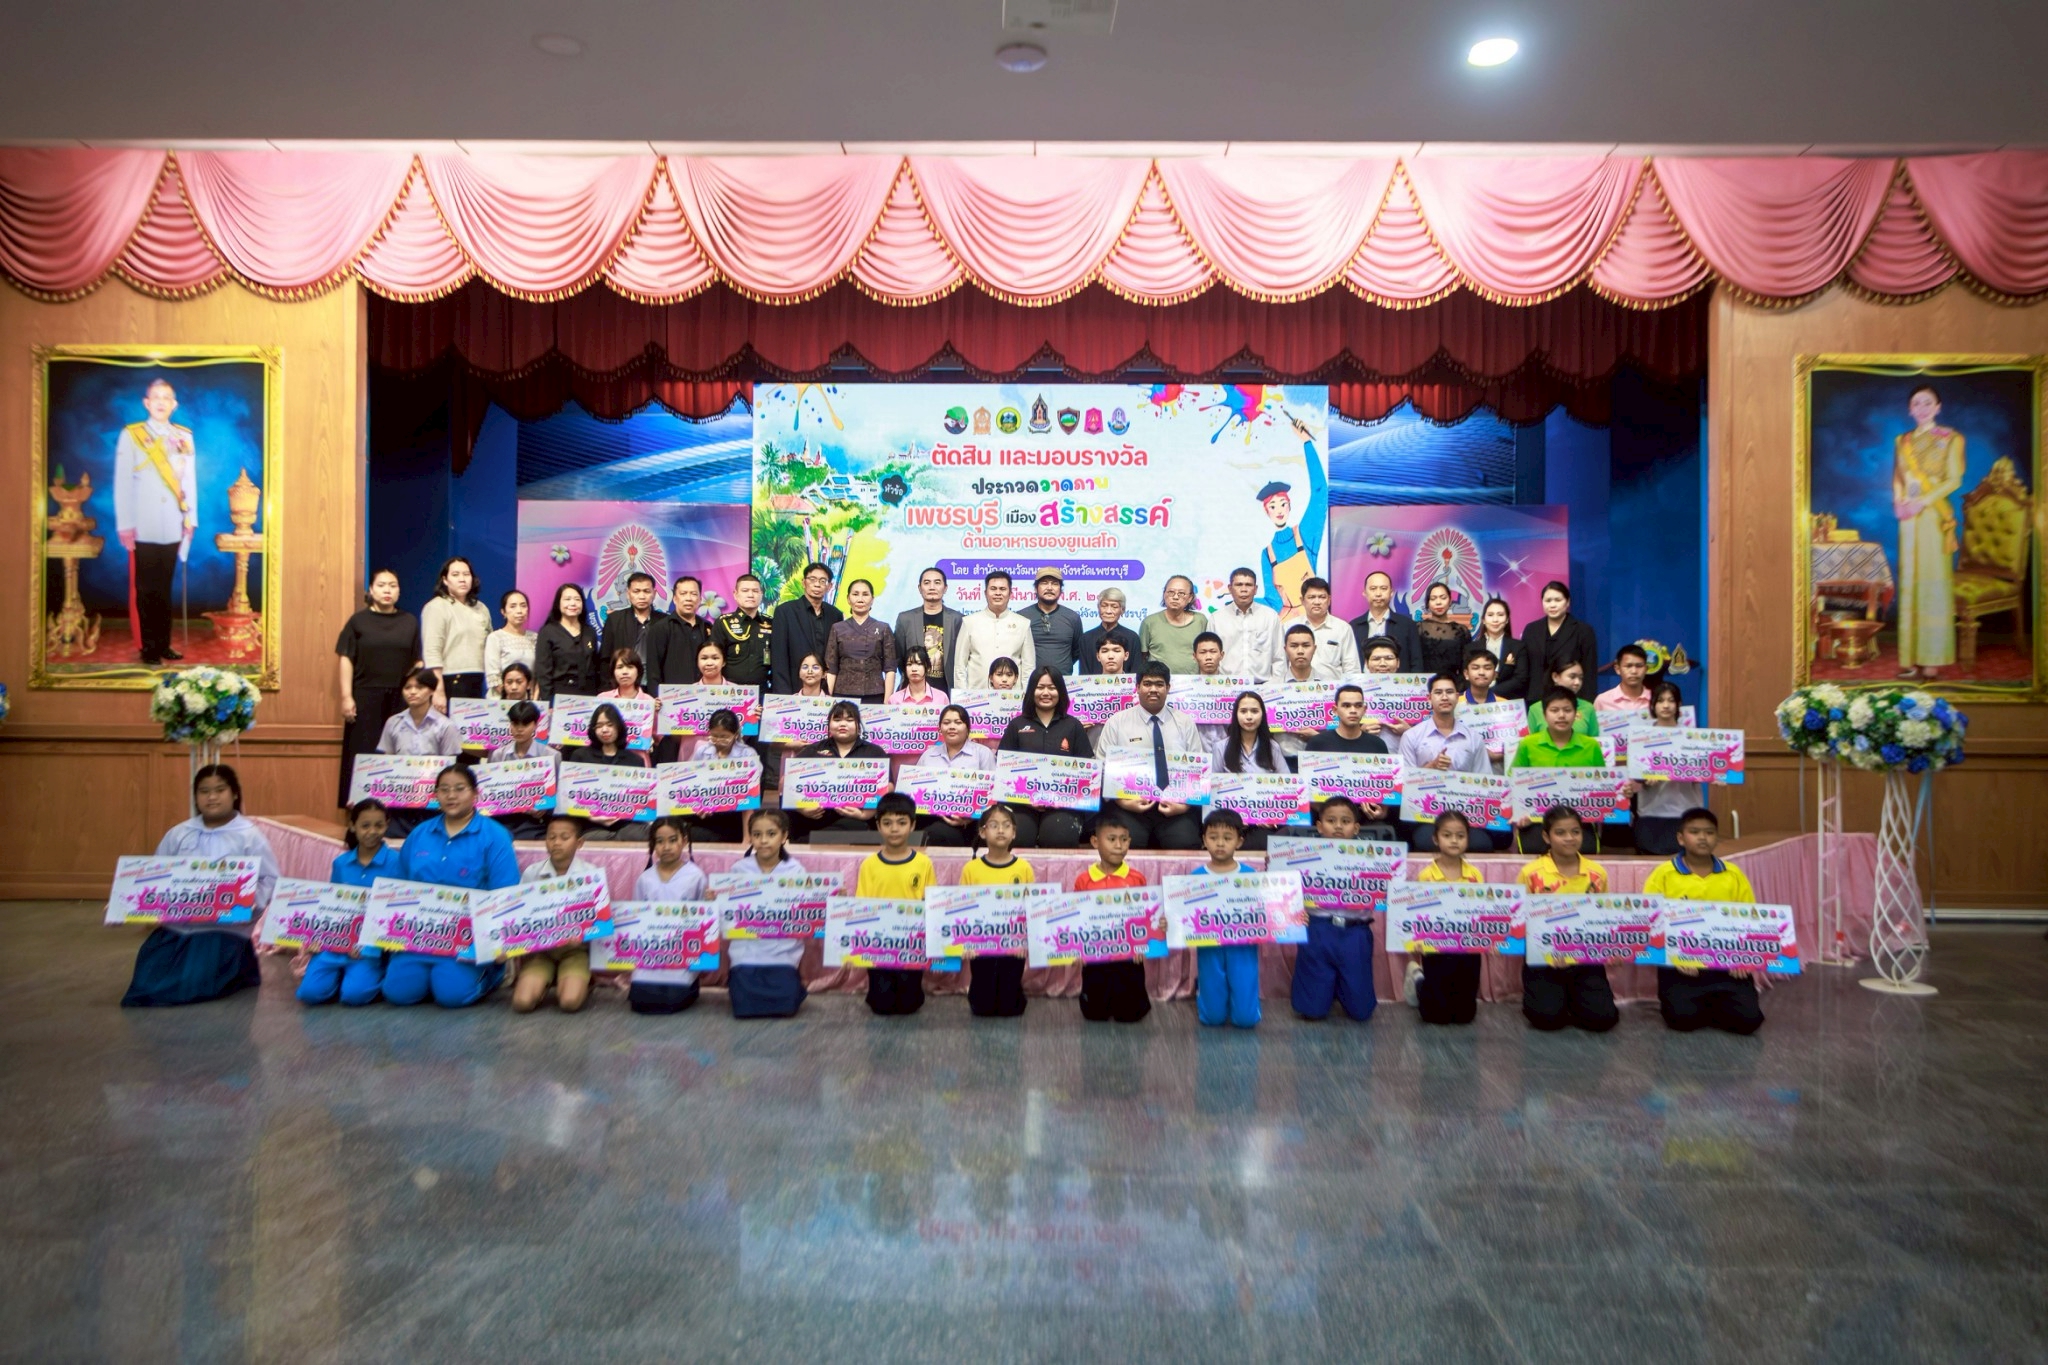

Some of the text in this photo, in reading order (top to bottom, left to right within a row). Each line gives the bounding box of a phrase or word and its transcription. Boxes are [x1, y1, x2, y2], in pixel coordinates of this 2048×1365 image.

[931, 443, 1149, 466] ตัดสิน และมอบรางวัล
[907, 498, 1172, 532] เพชรบุรี เมือง สร้างสรรค์
[963, 532, 1117, 553] ด้านอาหารของยูเนสโก
[951, 562, 969, 576] โดย
[956, 584, 982, 601] วันที่
[1074, 697, 1121, 712] รางวัลที่
[1167, 698, 1236, 712] รางวัลชมเช
[1276, 703, 1325, 721] รางวัลที่
[1285, 719, 1325, 728] ๑๐,๐๐๐
[862, 727, 938, 741] รางวัลชมเชย
[892, 741, 925, 750] ๒,๐๐๐
[1653, 751, 1726, 768] รางวัลที่ ๒
[668, 783, 749, 799] รางวัลชมเชย
[795, 780, 877, 793] รางวัลชมเชย
[1026, 776, 1091, 796] รางวัลที่ ๑
[1311, 776, 1394, 789] รางวัลชมเชย
[567, 789, 649, 804] รางวัลชมเชย
[923, 787, 989, 805] รางวัลที่ ๒
[1214, 796, 1298, 809] รางวัลชมเชย
[1525, 794, 1615, 808] รางวัลชมเชย
[933, 803, 973, 813] ๑๐,๐๐๐
[1431, 798, 1500, 816] รางวัลที่ ๒
[1302, 869, 1387, 892] งวัลชมเชย
[145, 886, 216, 905] รางวัลที่
[1341, 892, 1371, 904] ๕๐๐
[724, 904, 826, 922] รางวัลชมเชย
[1200, 902, 1267, 926] รางวัลที่
[292, 914, 351, 934] รางวัลที่
[395, 915, 458, 939] รางวัลที่
[489, 908, 596, 941] รางวัลชมเชย
[941, 918, 1026, 938] รางวัลชมเ
[1059, 920, 1147, 944] รางวัลที่ ๒
[1223, 926, 1267, 939] ๓,๐๐๐
[1402, 915, 1510, 935] รางวัลชมเชย
[620, 931, 682, 950] รางวัลที่
[840, 931, 926, 949] รางวัลชมเ
[1461, 935, 1491, 948] ๕๐๐
[1541, 927, 1650, 946] รางวัลชมเชย
[1667, 932, 1781, 954] รางวัลชมเชย
[1083, 943, 1130, 958] ๒,๐๐๐
